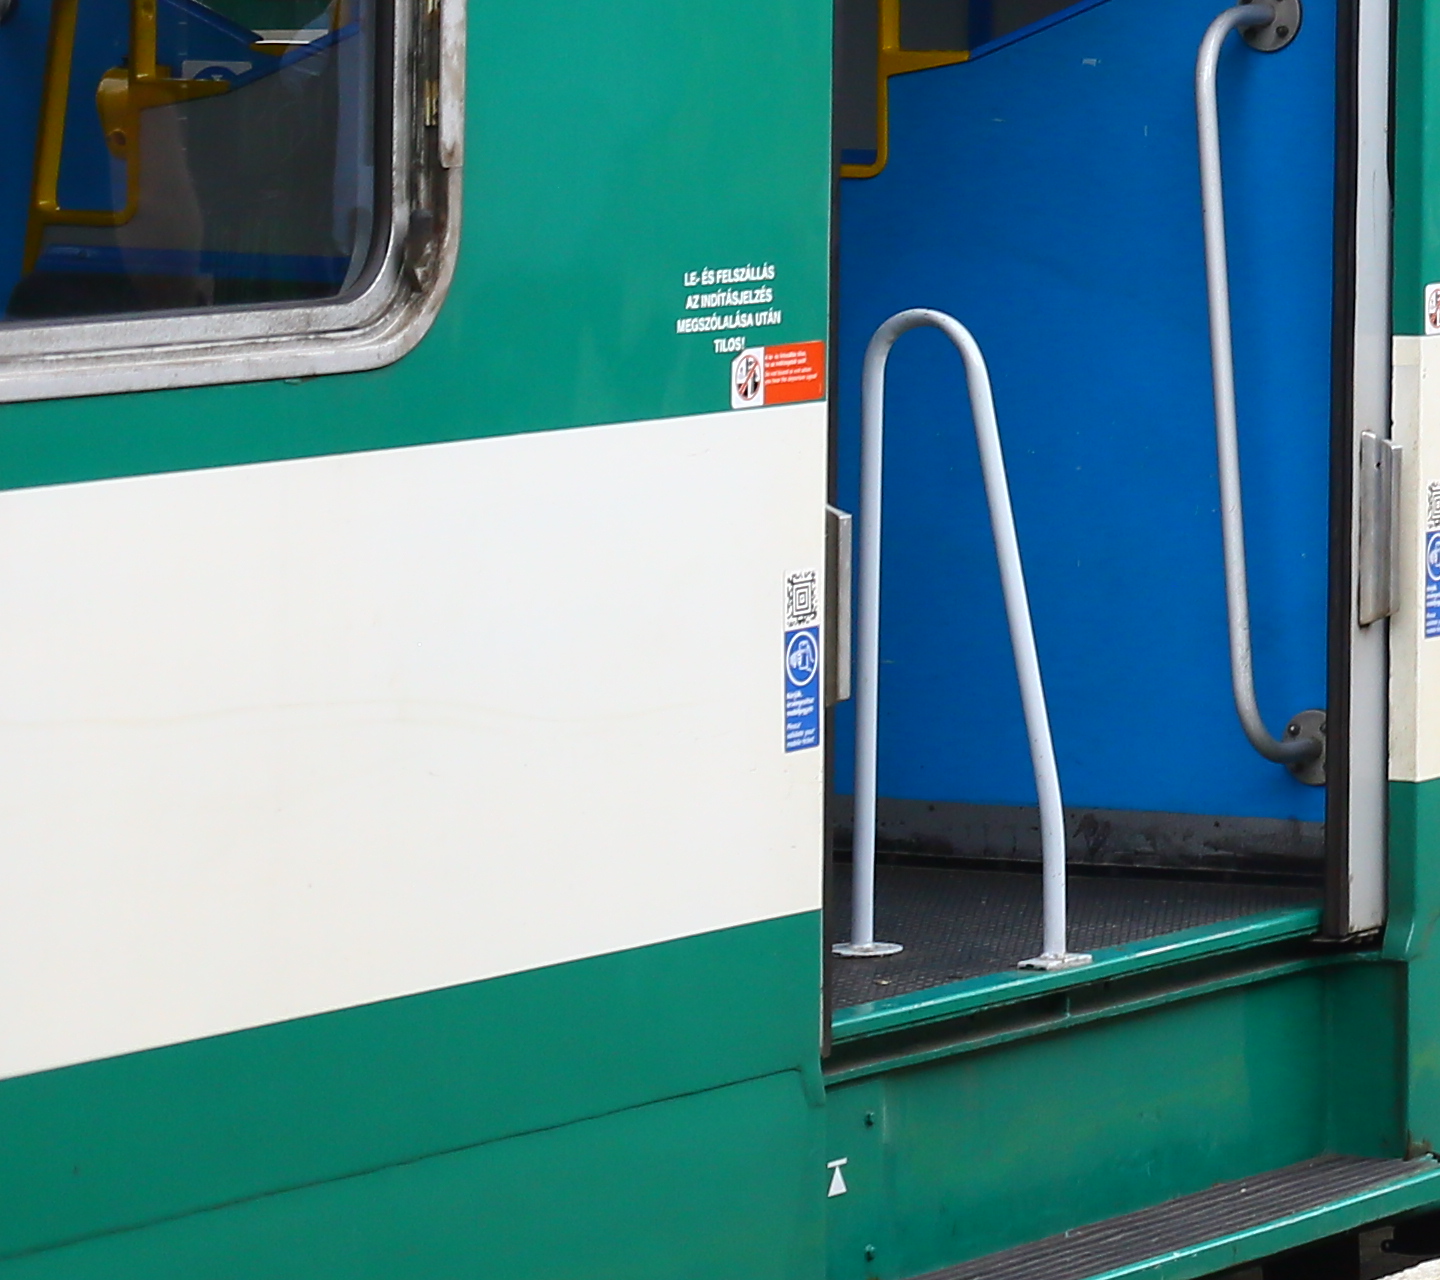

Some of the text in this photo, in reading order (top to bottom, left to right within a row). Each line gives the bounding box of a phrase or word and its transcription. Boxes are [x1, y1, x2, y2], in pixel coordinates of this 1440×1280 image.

[684, 262, 775, 286] LE- ÉS FELSZÁLLÁS
[685, 284, 773, 310] AZ INDÍTÁSJELZÉS
[676, 307, 782, 334] MEGSZÓLALÁSA UTÁN
[713, 336, 746, 354] TILOS!
